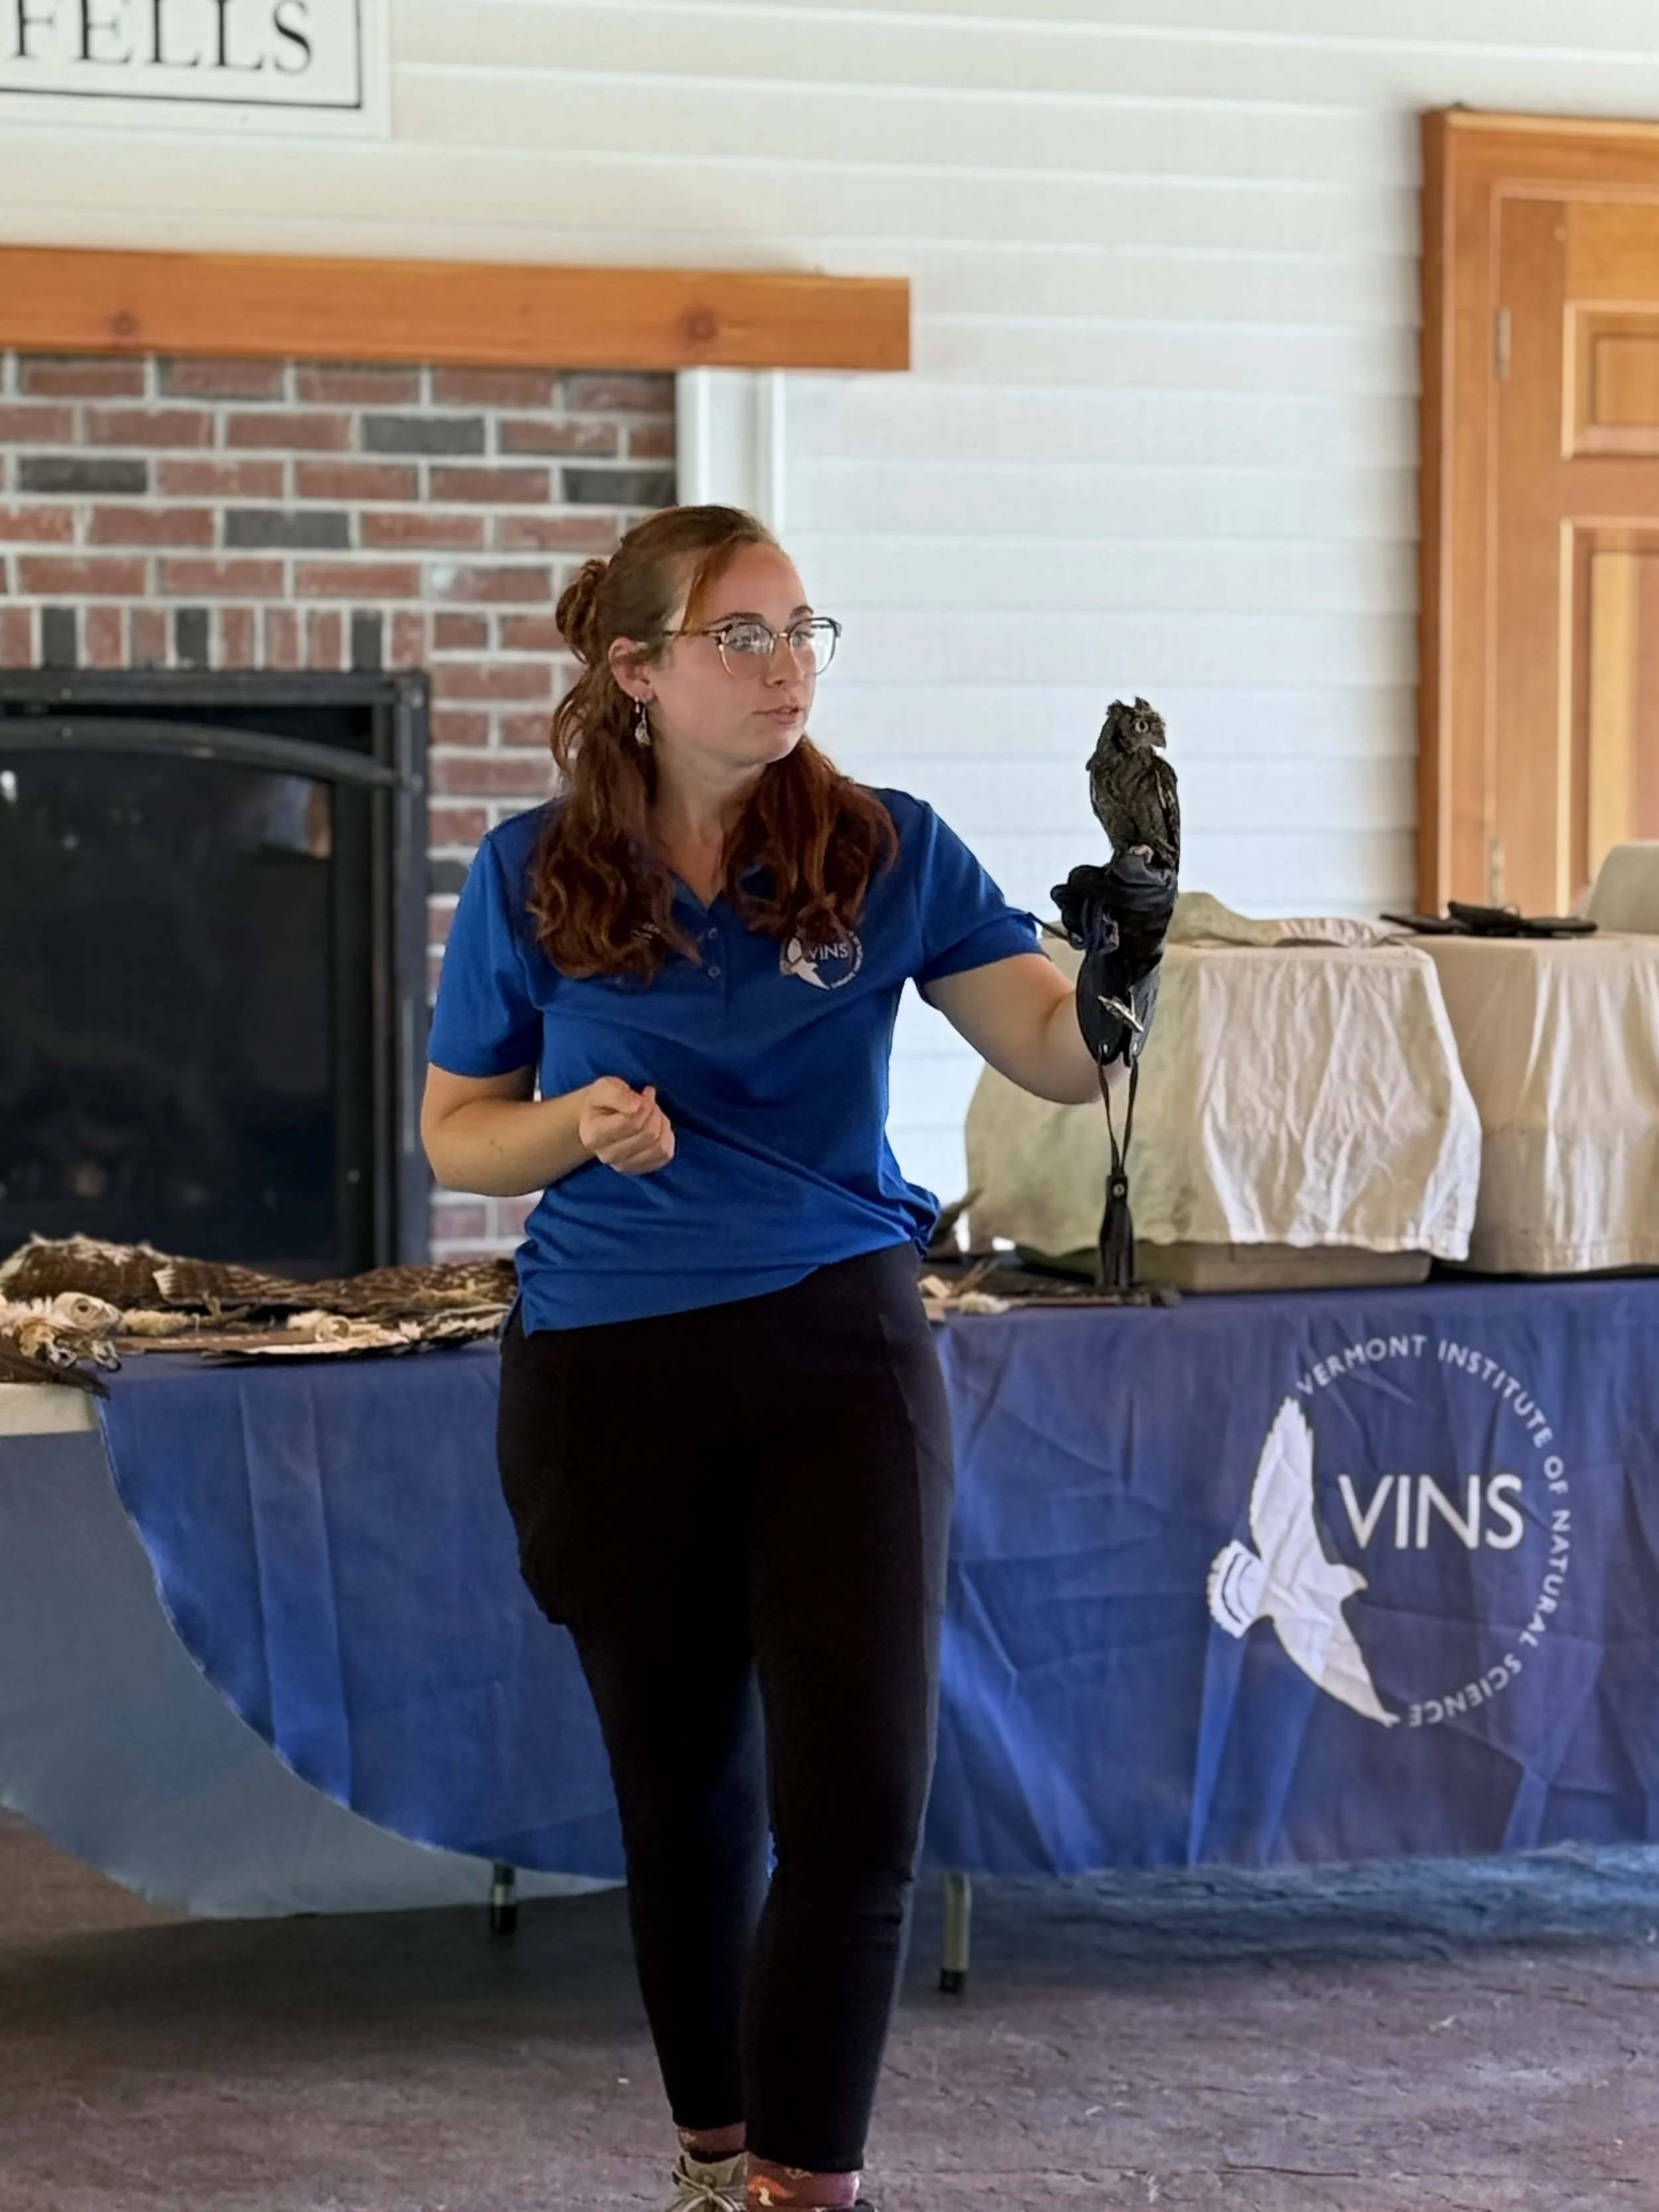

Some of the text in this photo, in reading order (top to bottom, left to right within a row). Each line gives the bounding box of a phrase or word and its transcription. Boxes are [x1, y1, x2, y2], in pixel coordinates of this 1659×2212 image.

[9, 0, 313, 74] FELLS
[809, 943, 849, 960] VINS
[1296, 1334, 1571, 1728] VERMONT INSTITUTE OF NATURAL SCIENCE
[1338, 1474, 1524, 1550] VINS
